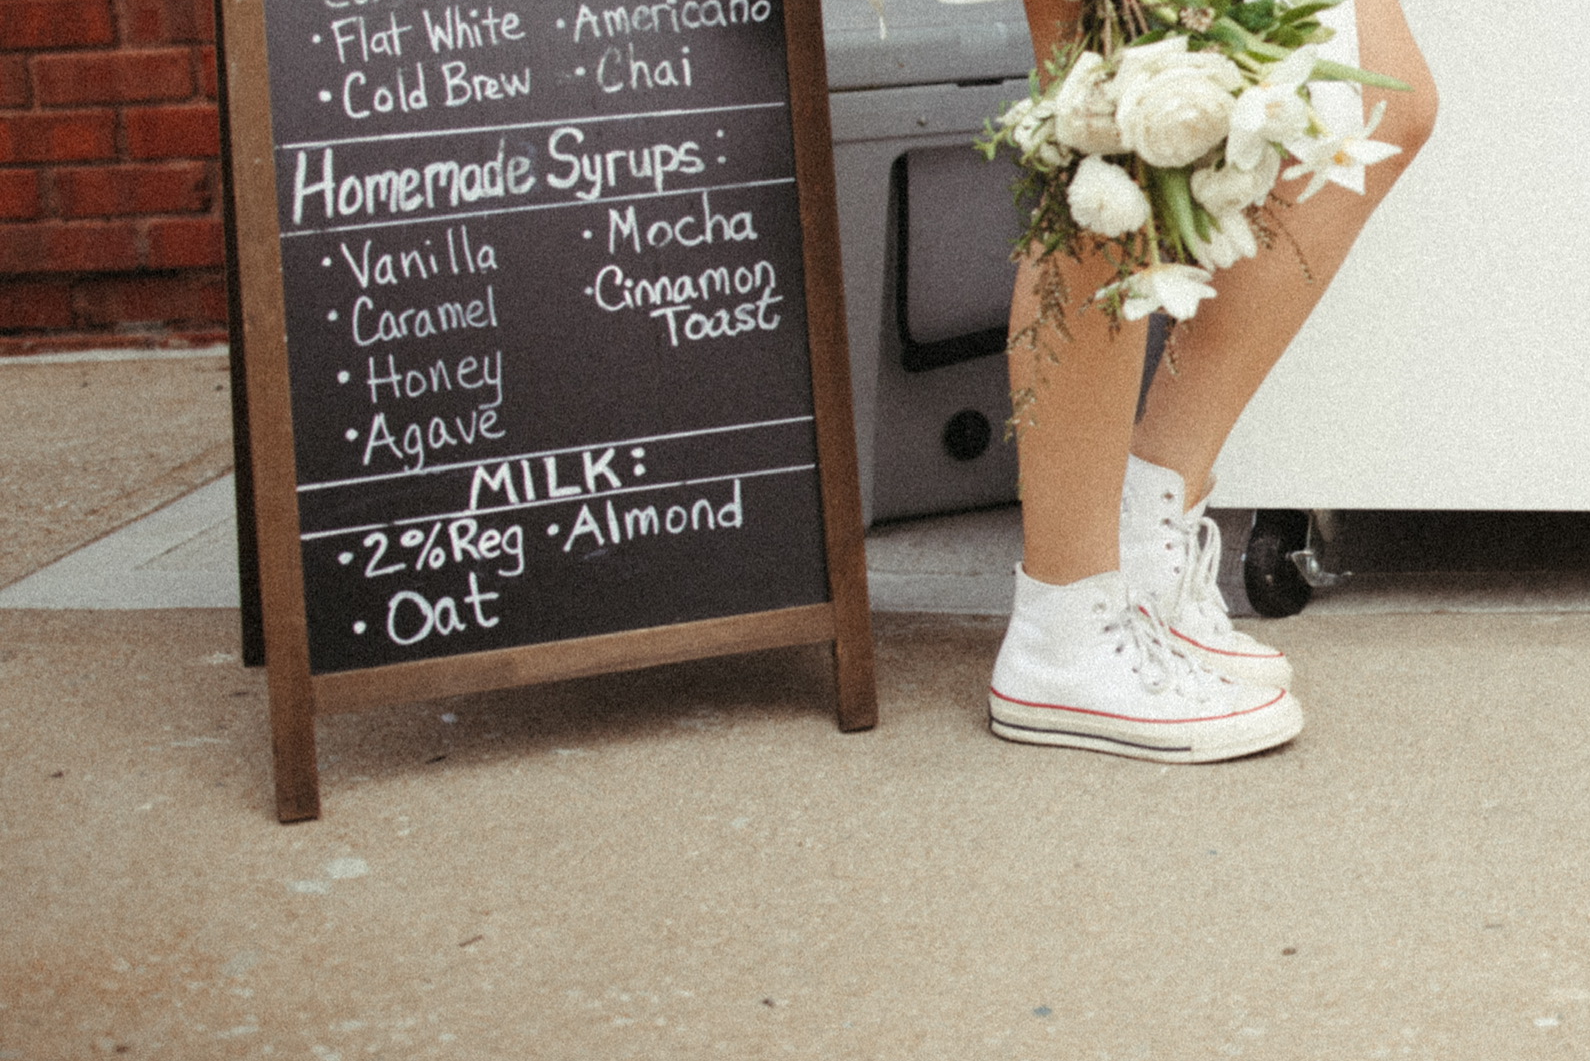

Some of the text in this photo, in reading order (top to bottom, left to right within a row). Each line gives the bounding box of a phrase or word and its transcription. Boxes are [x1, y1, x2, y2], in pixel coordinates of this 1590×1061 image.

[331, 4, 526, 64] Flat White
[342, 62, 531, 119] Cold Brew
[597, 46, 694, 93] Chai
[291, 139, 537, 225] Homemade
[608, 190, 758, 254] Mocha
[341, 225, 498, 289] Vanilla
[593, 260, 776, 309] Cinnamon
[351, 286, 498, 347] Caramel
[650, 292, 784, 347] Toast
[367, 349, 504, 408] Honey
[361, 410, 507, 473] Agave
[468, 446, 647, 511] MILK:
[562, 479, 744, 552] Almond
[387, 572, 501, 646] Oat
